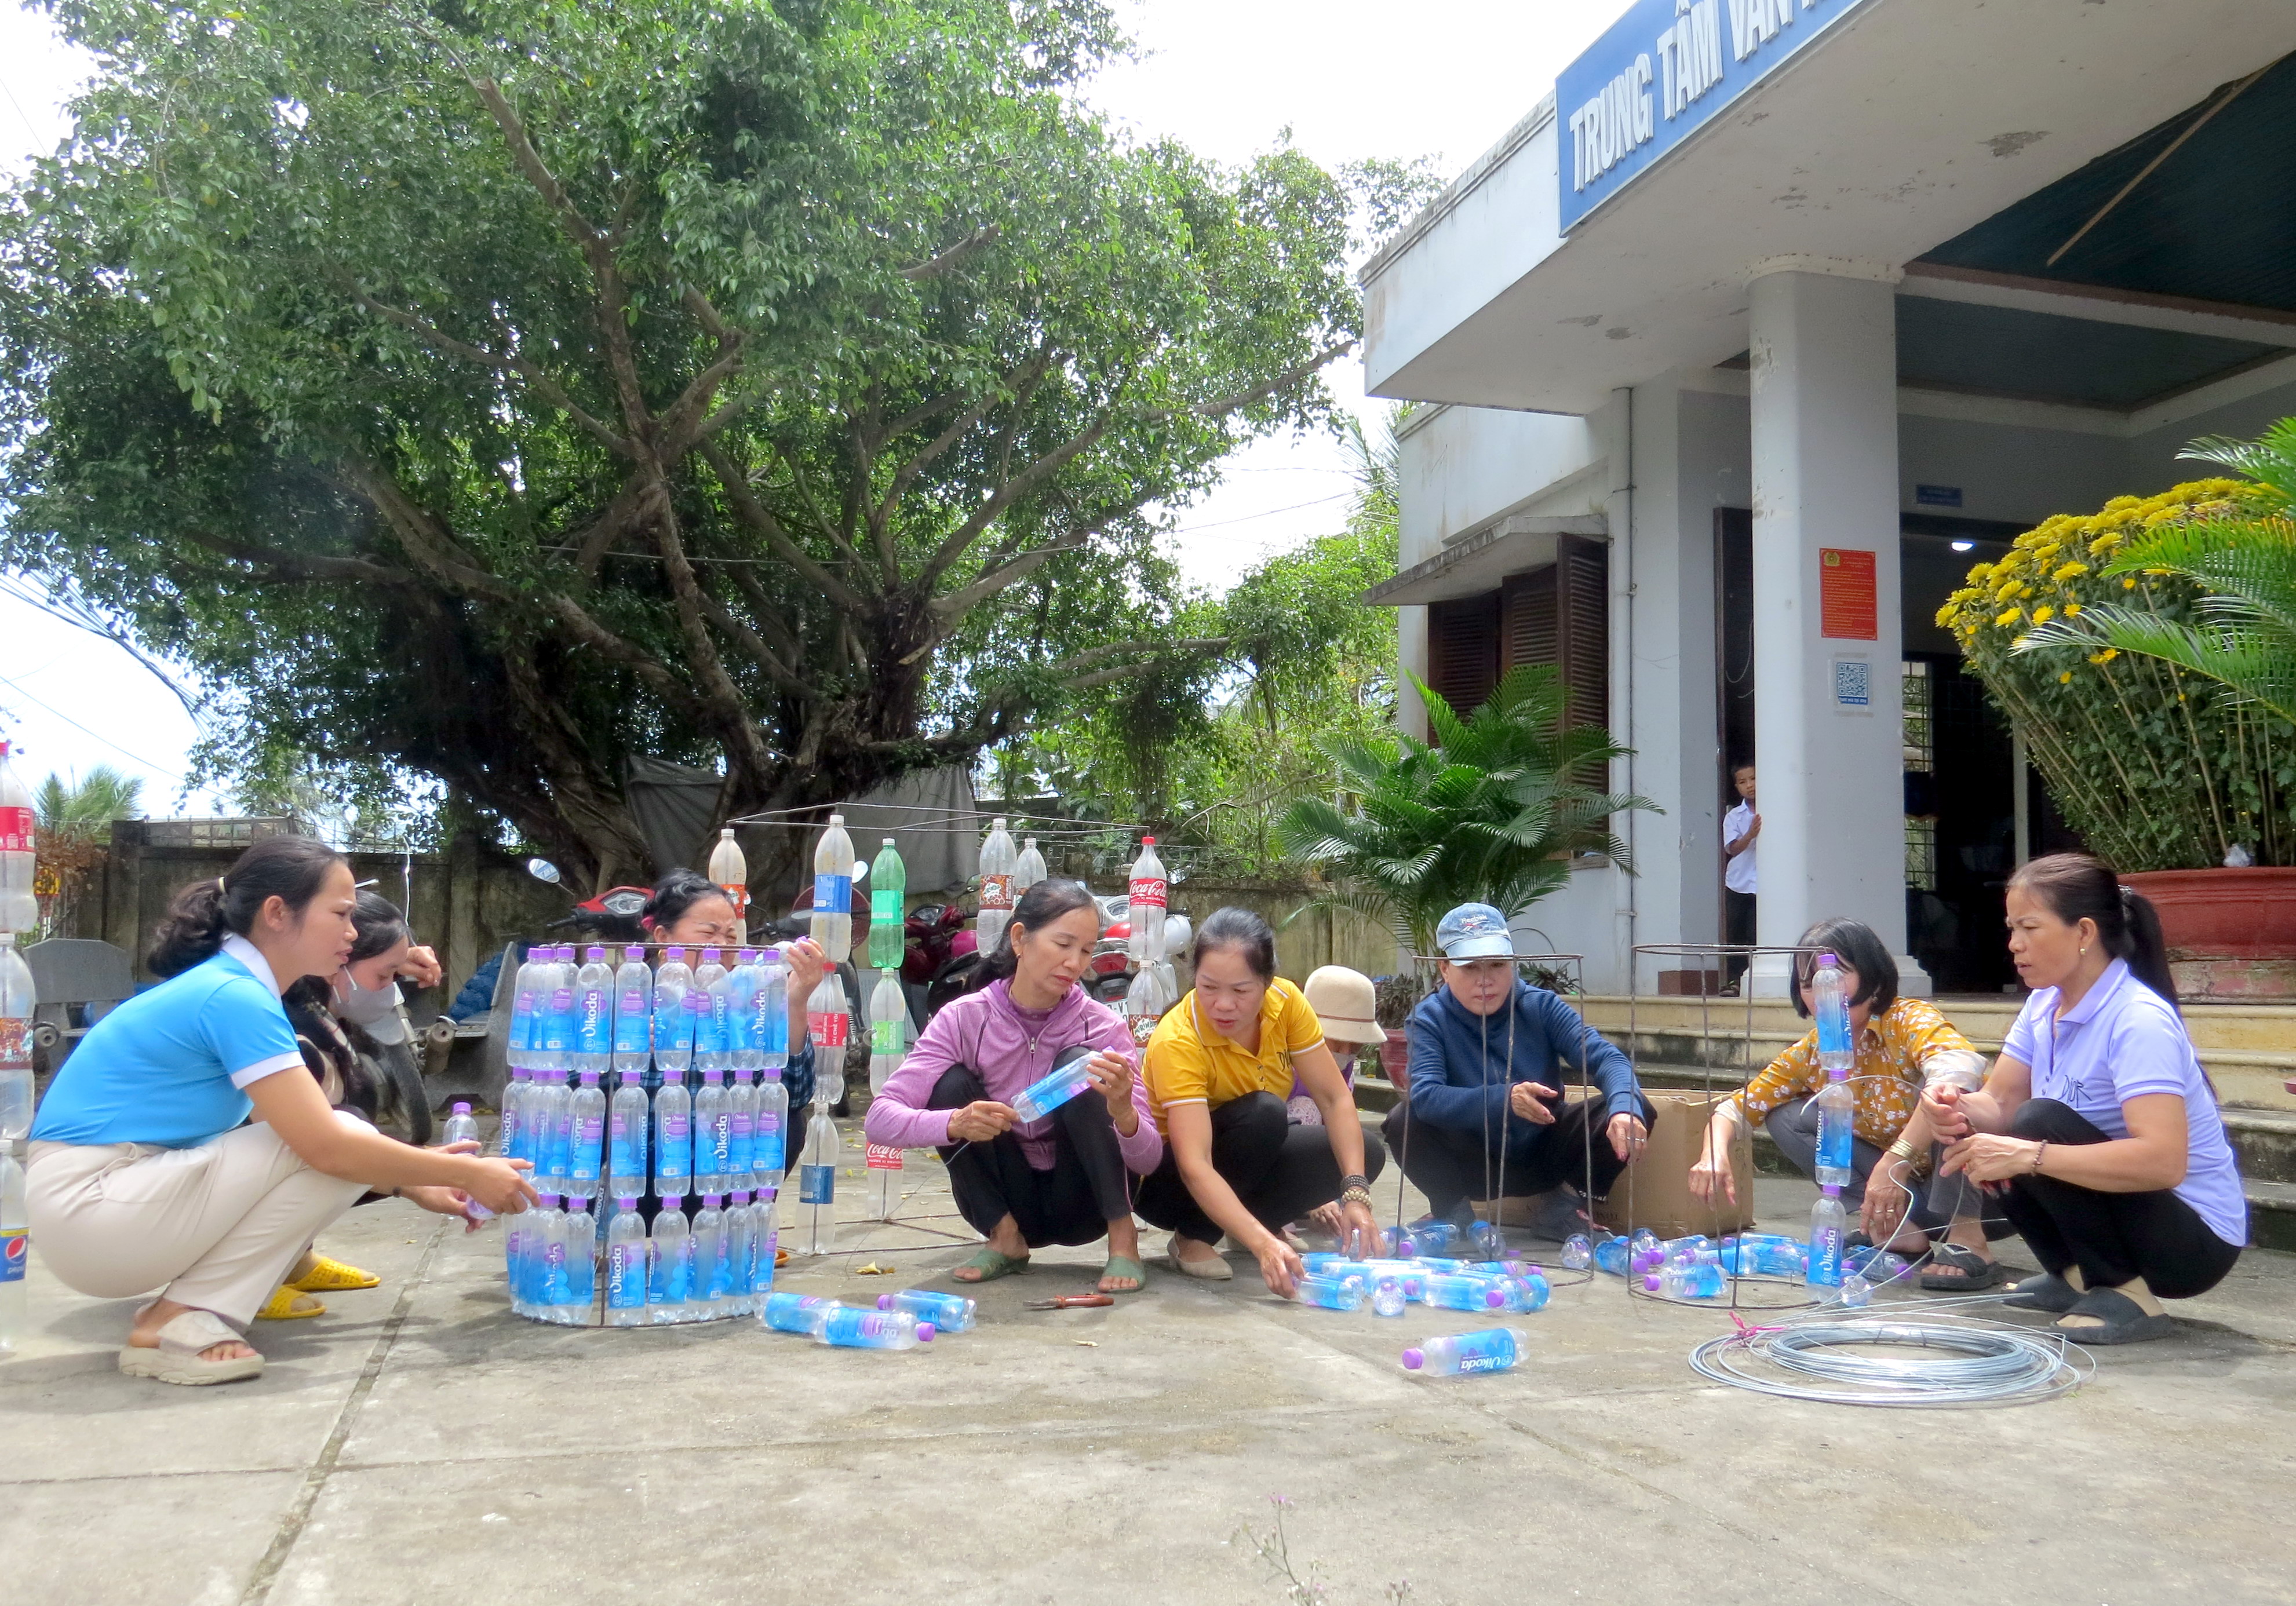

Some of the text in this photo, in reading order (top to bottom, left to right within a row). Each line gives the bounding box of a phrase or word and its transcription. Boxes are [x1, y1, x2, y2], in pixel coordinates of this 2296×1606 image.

[1569, 53, 1653, 192] TRUNG
[1129, 880, 1166, 899] Coca-Cola
[1461, 914, 1488, 924] Reebok
[581, 992, 597, 1037] Vikoda
[752, 991, 765, 1035] Vikoda
[713, 1115, 728, 1159] Vikoda
[610, 1247, 622, 1293] Vikoda
[1818, 1230, 1836, 1271] Vikoda
[1460, 1356, 1501, 1371] Vikoda
